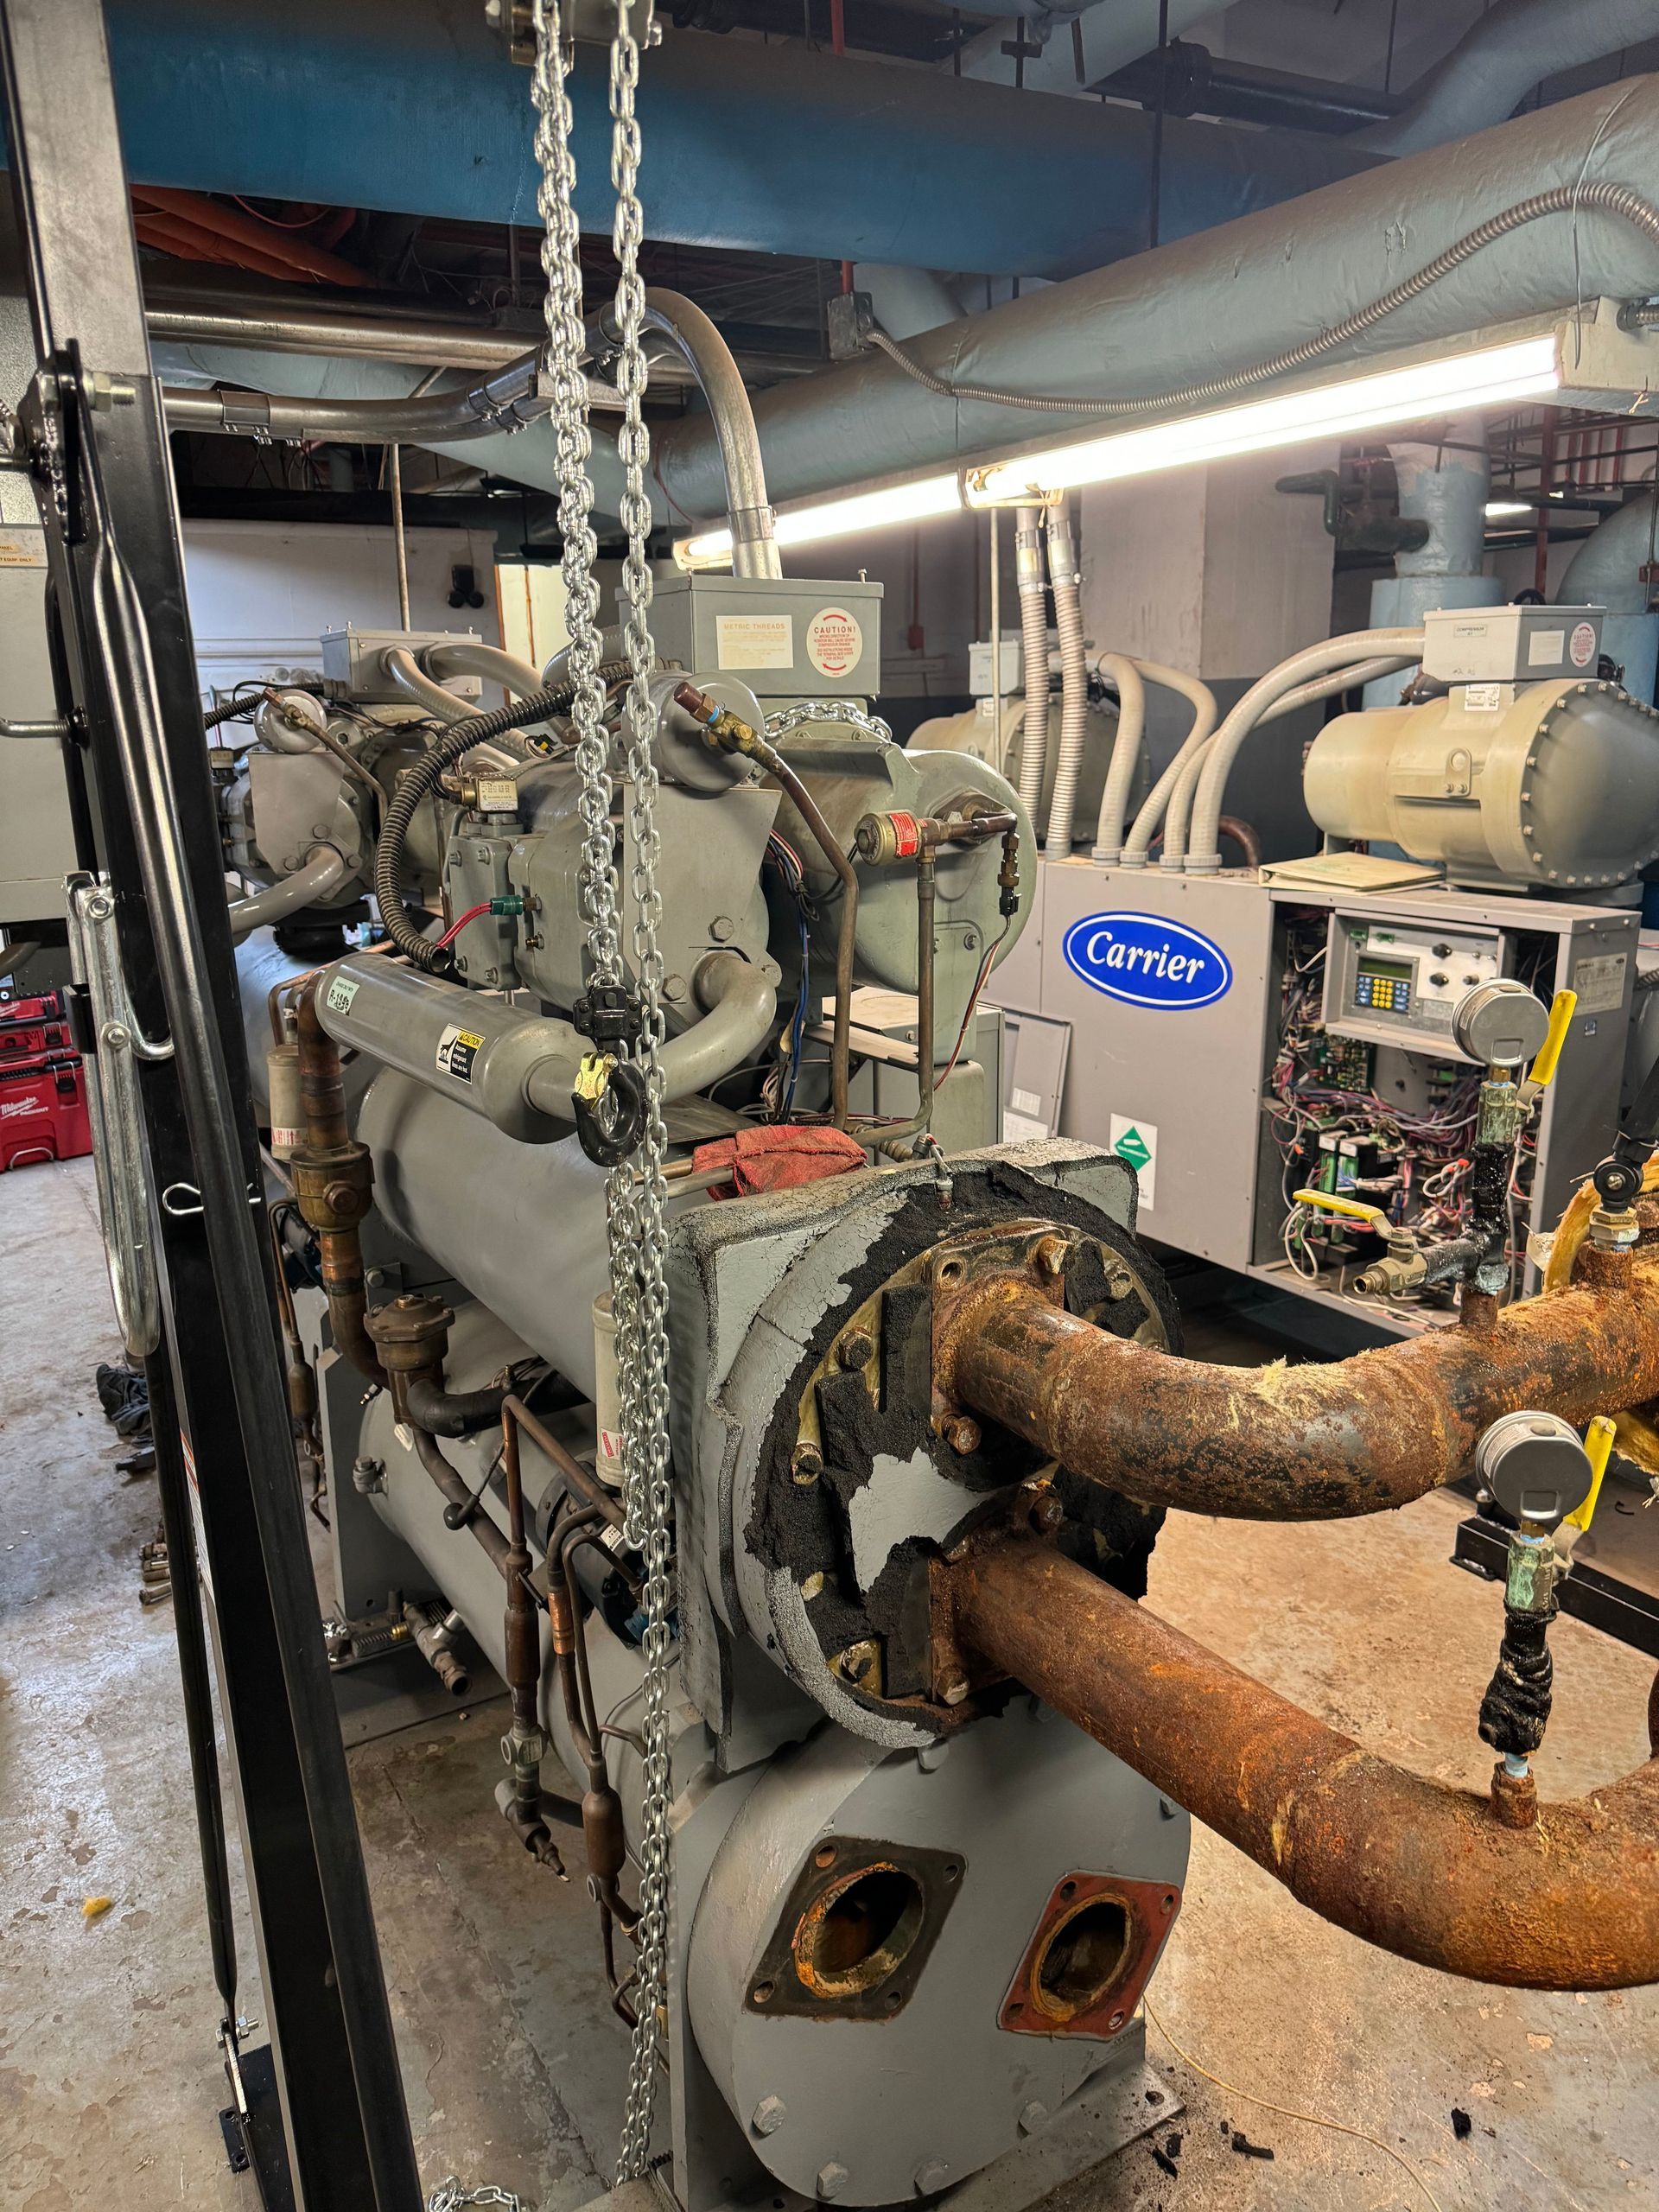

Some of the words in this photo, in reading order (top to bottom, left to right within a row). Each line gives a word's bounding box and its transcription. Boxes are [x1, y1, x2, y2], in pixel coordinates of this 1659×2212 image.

[1086, 931, 1205, 984] Carrier
[329, 989, 349, 1009] R-1
[1, 1096, 37, 1116] Milkee
